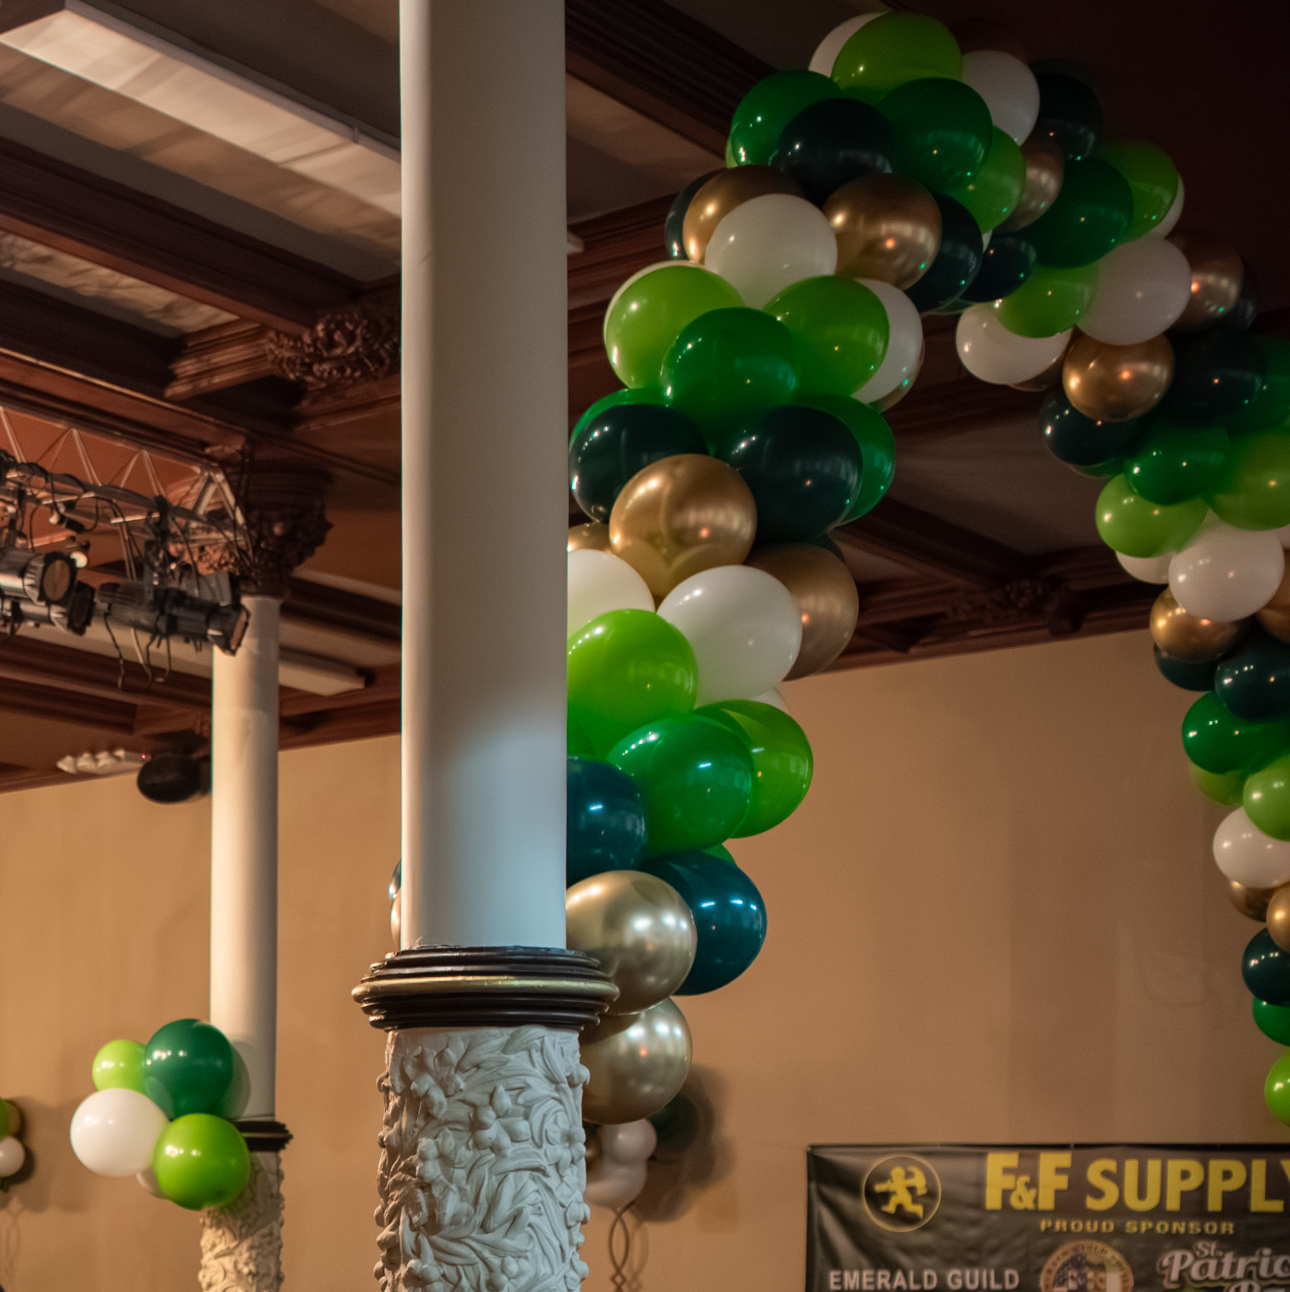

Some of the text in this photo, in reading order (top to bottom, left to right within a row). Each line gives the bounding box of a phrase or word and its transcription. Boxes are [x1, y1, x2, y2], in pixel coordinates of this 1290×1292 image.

[985, 1152, 1290, 1213] F&F SUPPL
[1040, 1219, 1235, 1235] PROUD SPONSOR
[829, 1268, 1020, 1291] EMERALD GUILD
